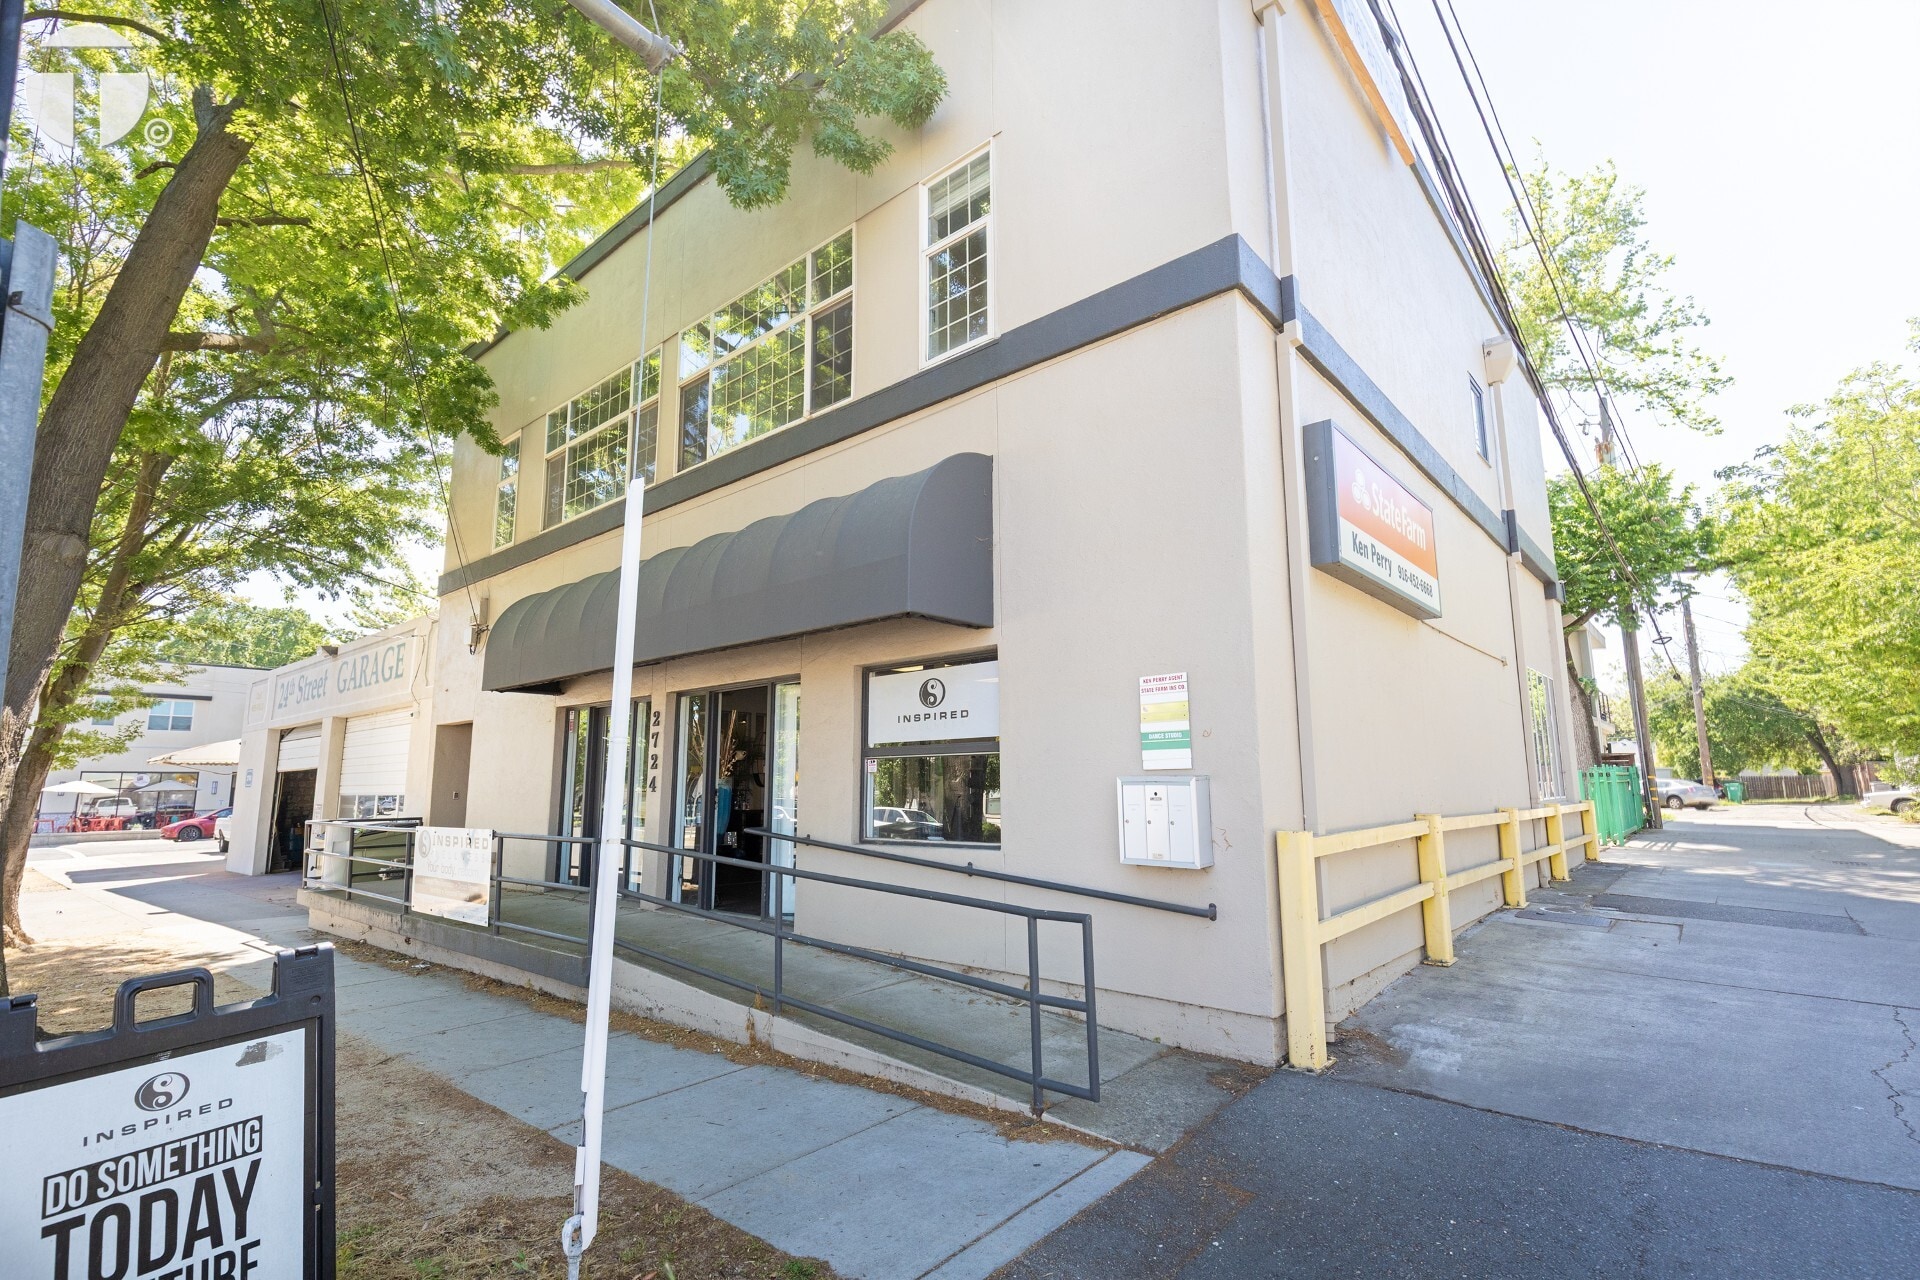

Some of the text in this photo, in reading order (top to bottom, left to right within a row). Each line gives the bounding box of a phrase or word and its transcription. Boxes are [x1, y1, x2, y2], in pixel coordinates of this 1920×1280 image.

[1352, 531, 1369, 559] Ken
[1371, 543, 1392, 577] Perry
[278, 680, 295, 709] 24th
[296, 669, 328, 705] Street
[337, 642, 406, 693] GARAGE
[897, 709, 970, 724] INSPIRED
[648, 710, 661, 793] 2724
[432, 834, 489, 850] INSPIRED
[82, 1097, 233, 1147] INSPIRED
[46, 1118, 261, 1217] DO SOMETHING
[41, 1157, 262, 1280] TODAY
